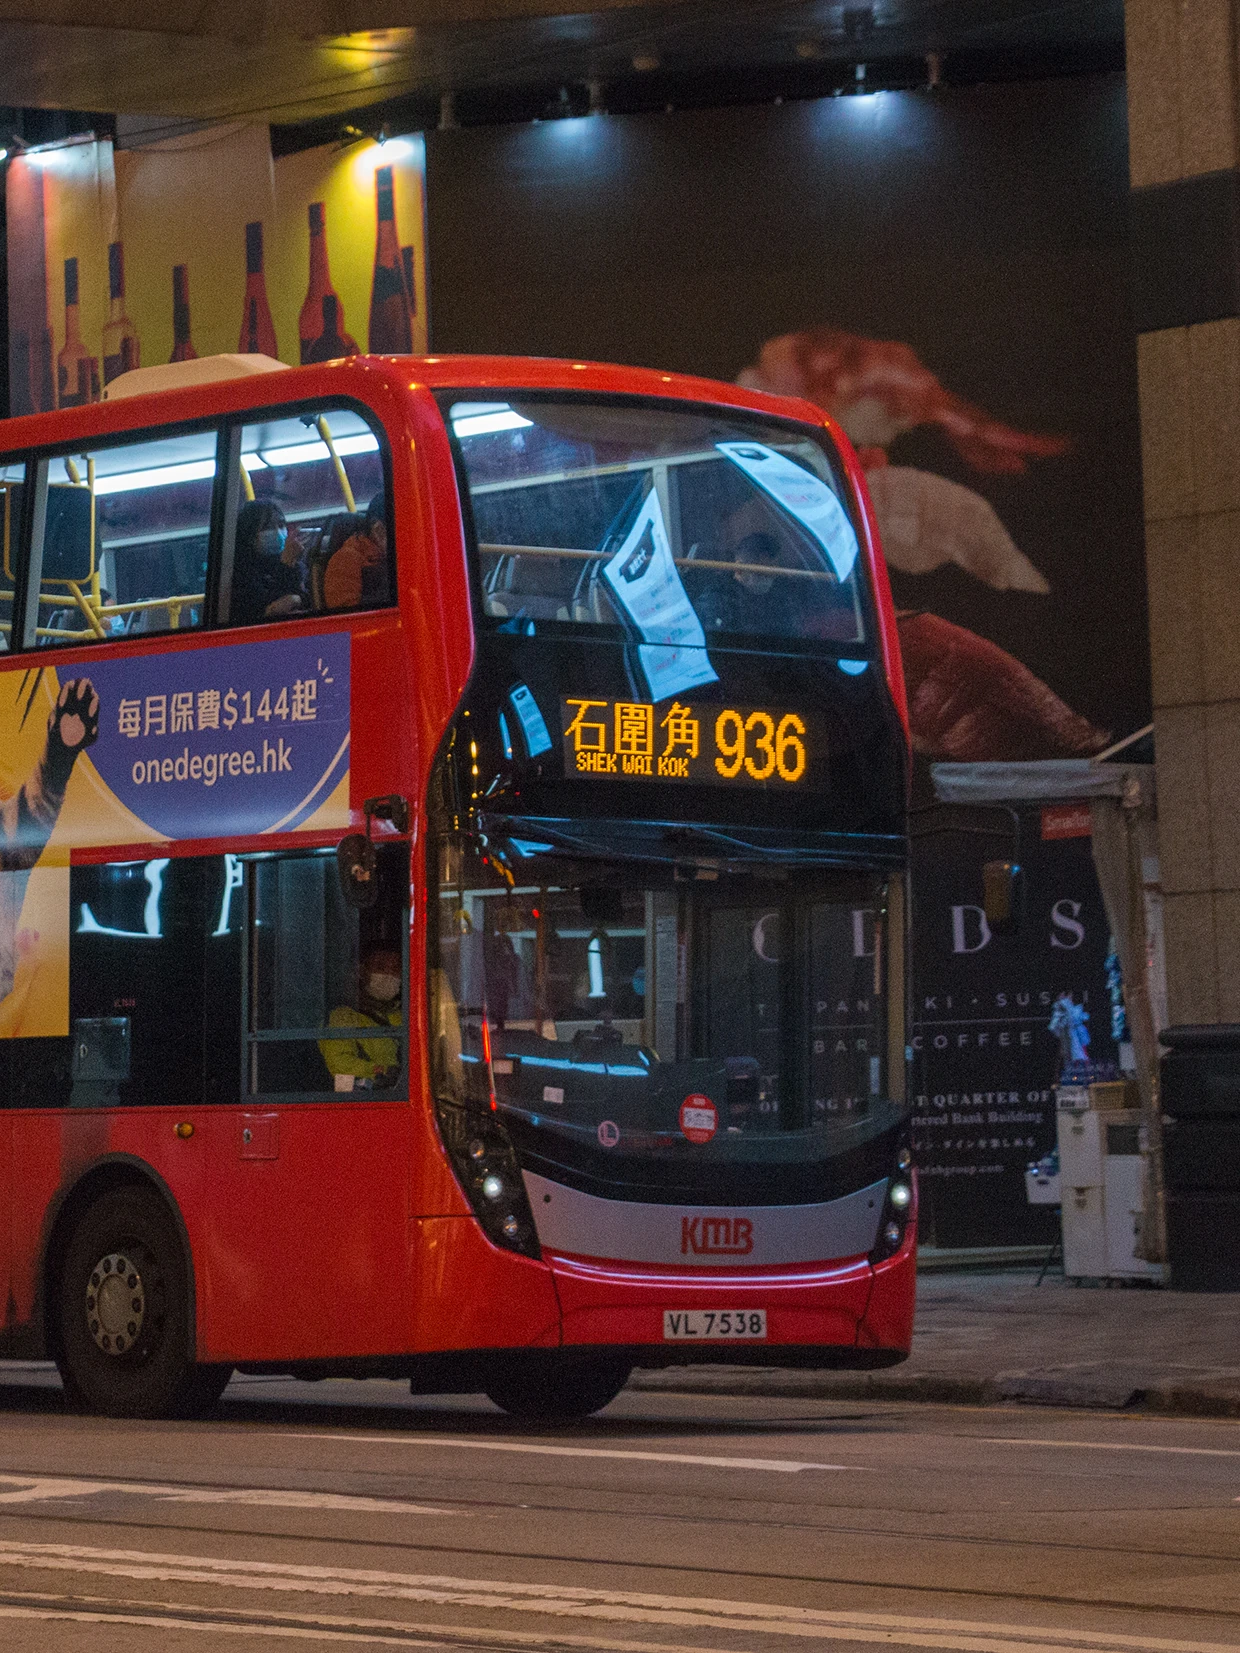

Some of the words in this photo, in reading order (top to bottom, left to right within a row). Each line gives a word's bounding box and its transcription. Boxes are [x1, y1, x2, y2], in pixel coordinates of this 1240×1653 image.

[118, 679, 317, 738] 每月保費$144起
[564, 699, 700, 758] 石圍角
[715, 710, 806, 782] 936
[132, 738, 293, 786] onedegree.hk
[576, 752, 617, 773] SHEK
[622, 755, 653, 775] WAI
[658, 757, 689, 777] KOK
[911, 1031, 1032, 1050] COFFEE
[933, 1091, 1019, 1108] QUARTER
[681, 1216, 753, 1255] KMB
[668, 1313, 697, 1335] VL
[704, 1313, 761, 1335] 7538
